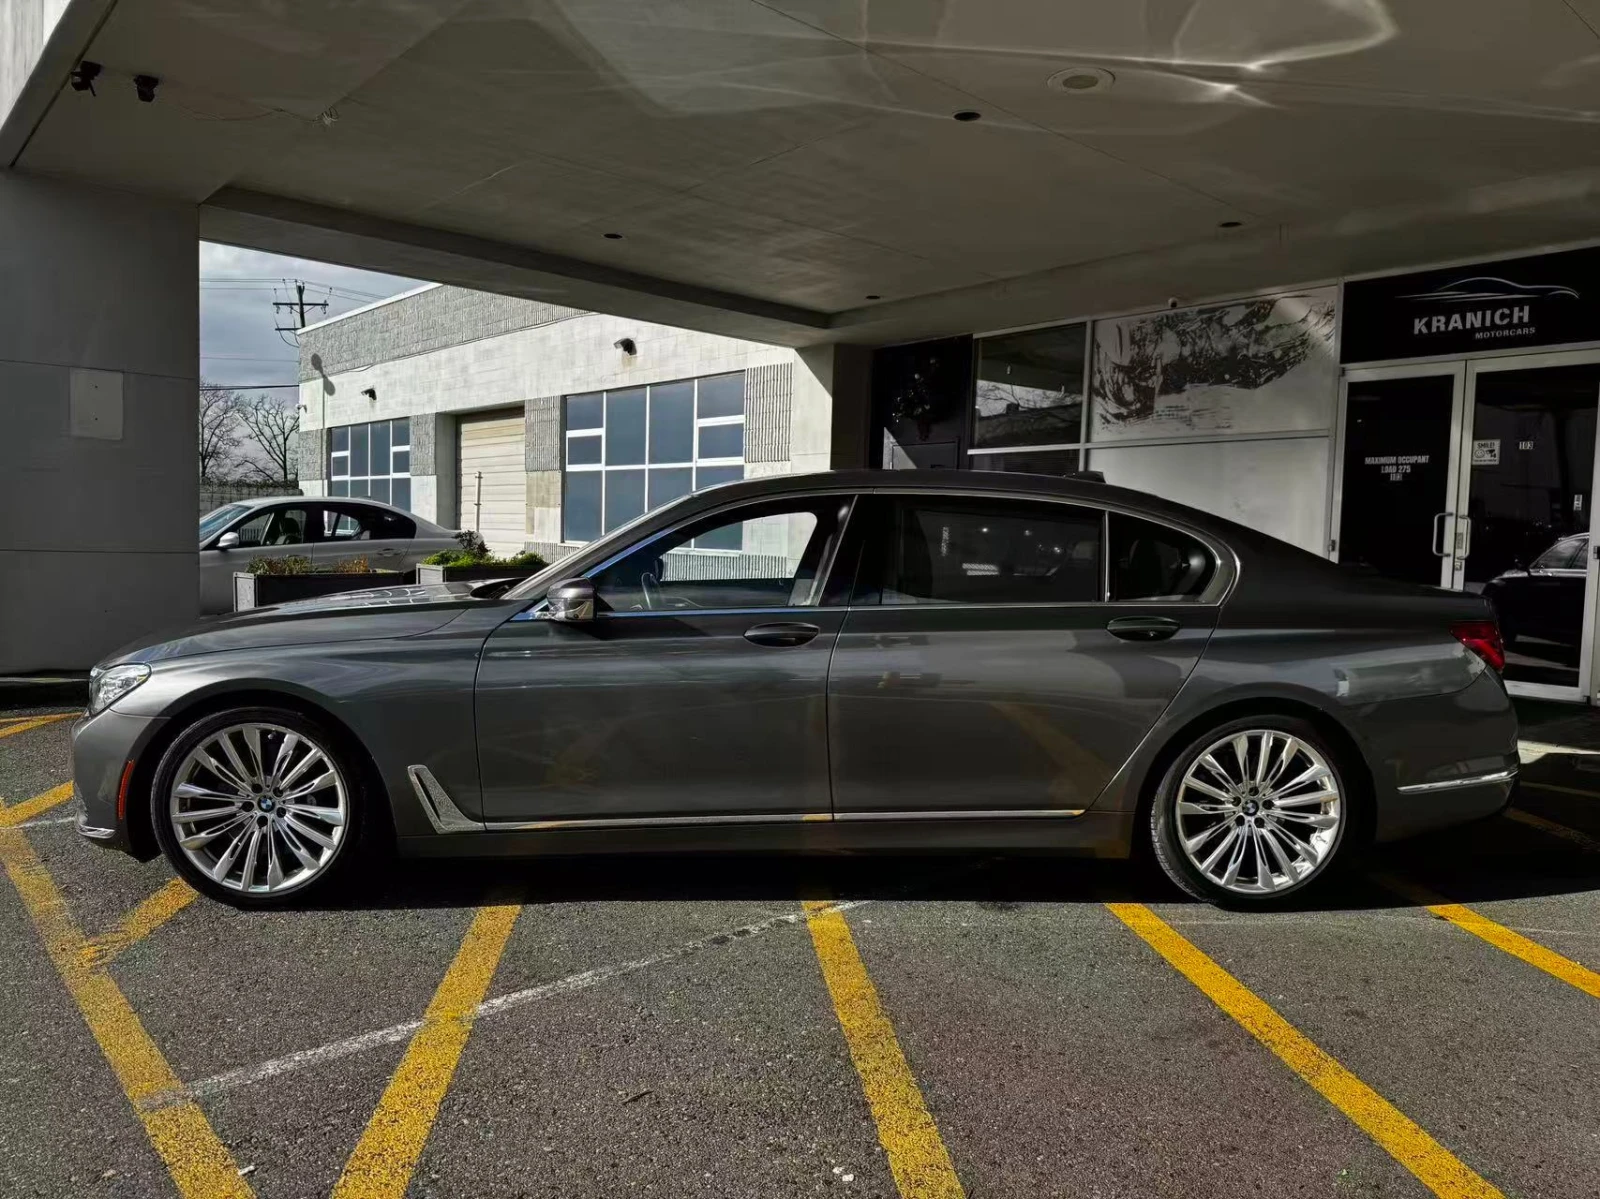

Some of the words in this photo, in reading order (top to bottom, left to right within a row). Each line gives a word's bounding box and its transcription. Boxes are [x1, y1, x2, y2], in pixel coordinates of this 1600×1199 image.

[1413, 305, 1530, 335] KRANICH
[1475, 327, 1536, 340] MOTORCARS
[1364, 456, 1397, 465] MAXIMUM
[1397, 455, 1430, 464] OCCUPANT
[1380, 465, 1397, 474] LOAD
[1397, 464, 1412, 473] 275
